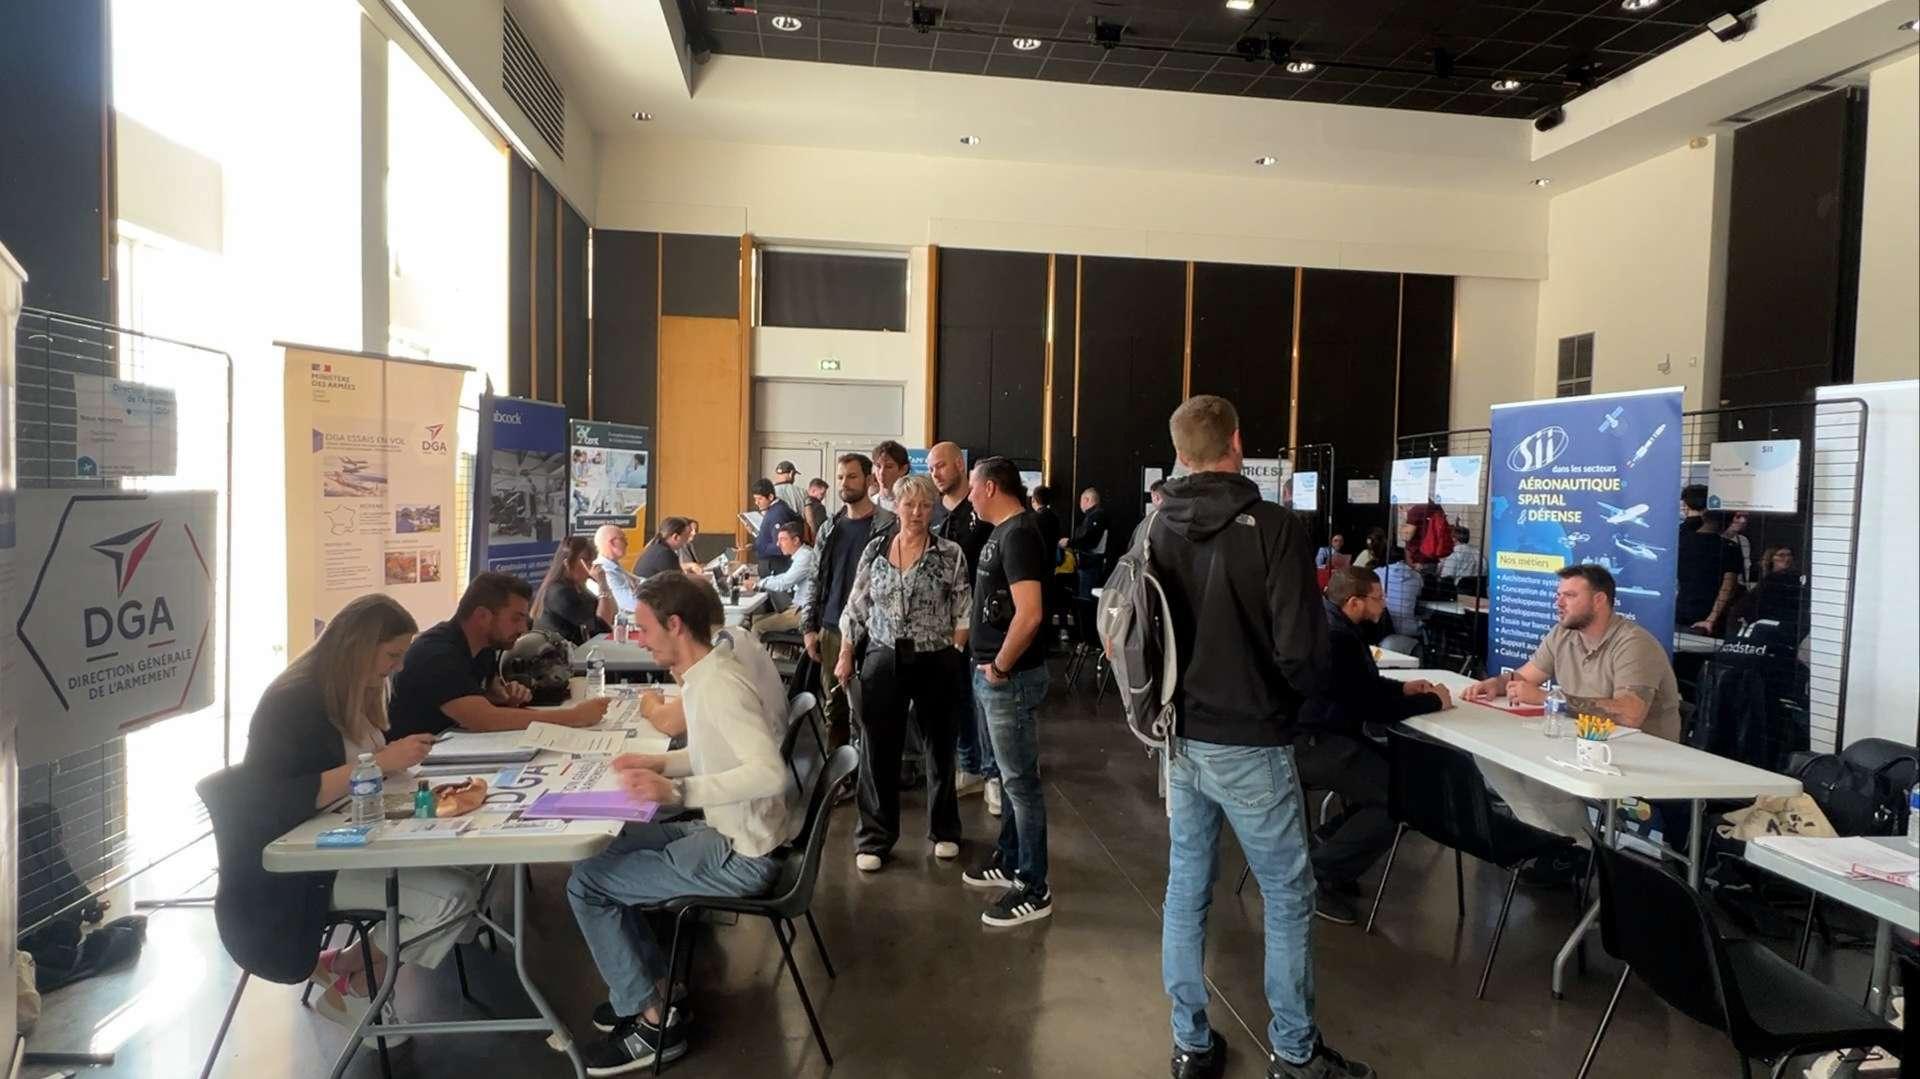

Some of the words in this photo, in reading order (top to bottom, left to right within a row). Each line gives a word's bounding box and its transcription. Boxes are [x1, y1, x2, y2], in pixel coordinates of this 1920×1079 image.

[325, 433, 345, 442] DGA
[347, 433, 375, 443] ESSAIS
[389, 436, 406, 445] VOL
[421, 441, 447, 451] DGA
[1552, 465, 1570, 473] dans
[1570, 464, 1582, 473] les
[1583, 465, 1617, 473] secteurs
[1518, 476, 1621, 492] AÉRONAUTIQUE
[1517, 494, 1567, 506] SPATIAL
[1528, 508, 1583, 523] DÉFENSE
[1500, 556, 1516, 566] Nos
[1518, 557, 1550, 568] métiers
[1501, 574, 1541, 585] Architecture
[1501, 585, 1538, 597] Conception
[1539, 589, 1547, 597] de
[1501, 595, 1551, 608] Développement
[1501, 606, 1551, 619] Développement
[84, 596, 175, 648] DGA
[1521, 619, 1531, 627] sur
[1501, 627, 1539, 639] Architecture
[1500, 638, 1526, 649] Support
[1500, 648, 1519, 658] Calcul
[68, 663, 135, 690] DIRECTION
[138, 648, 193, 672] GÉNÉRALE
[88, 687, 106, 700] DE
[109, 666, 178, 694] L'ARMEMENT
